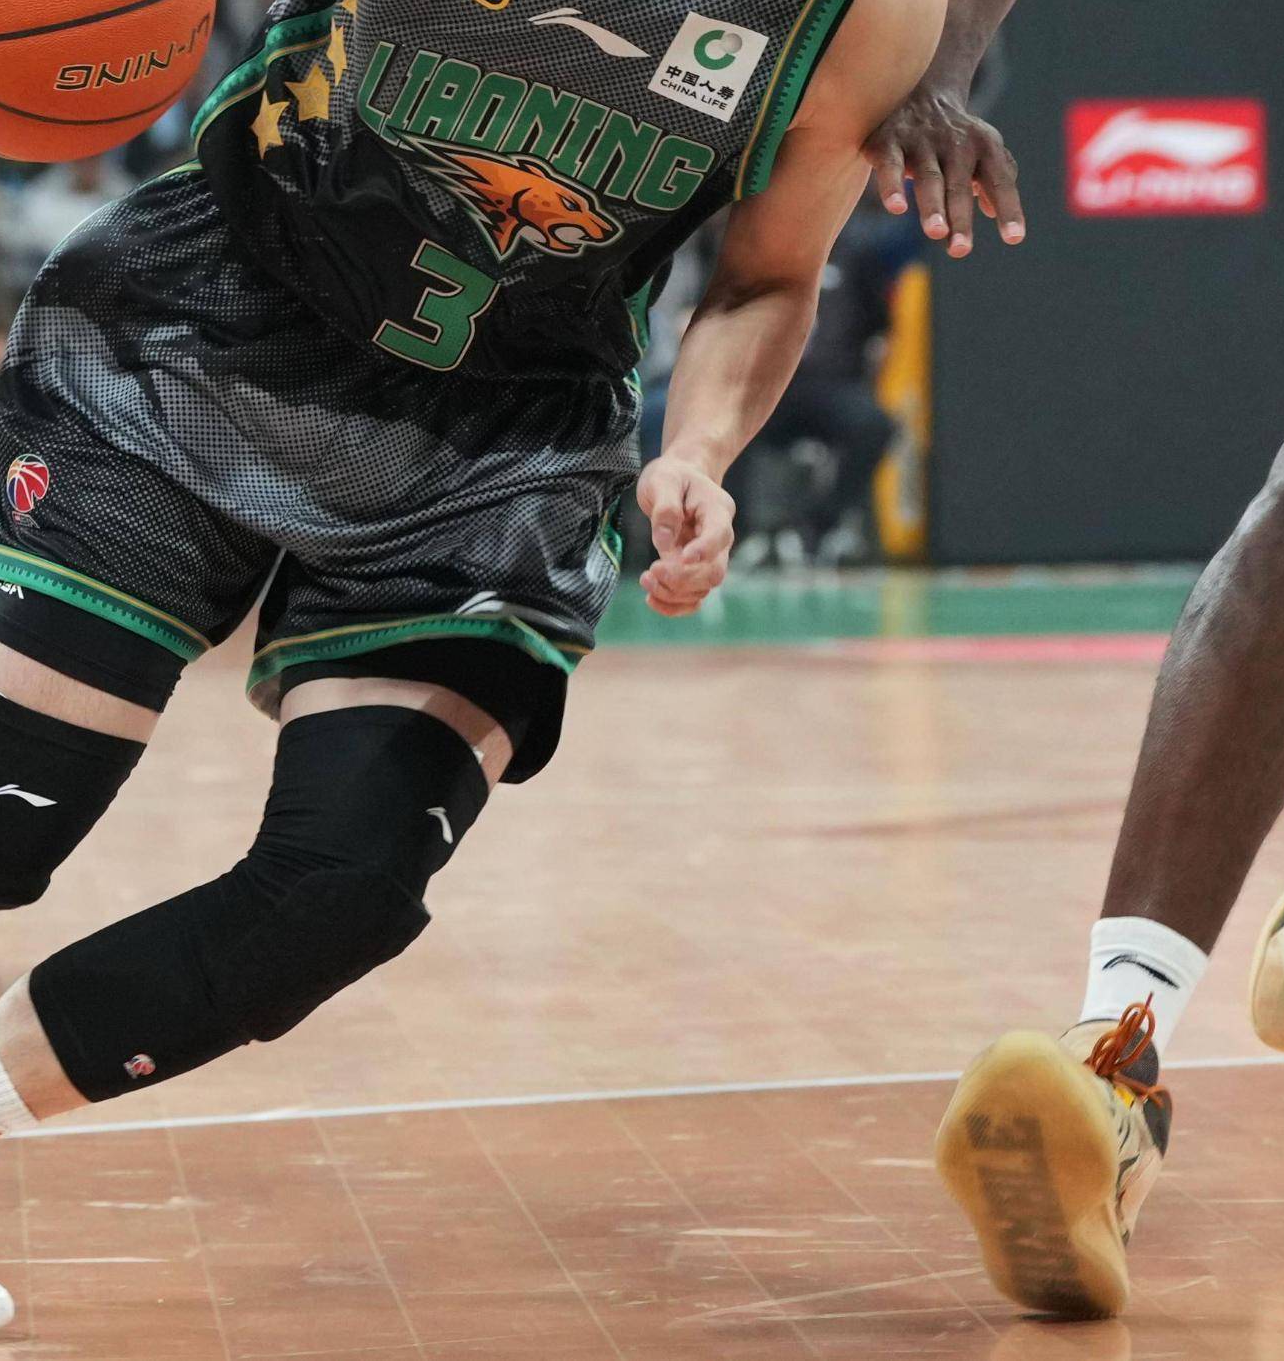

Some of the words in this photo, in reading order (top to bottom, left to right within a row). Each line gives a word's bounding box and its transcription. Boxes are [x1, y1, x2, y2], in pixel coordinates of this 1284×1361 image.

[54, 12, 210, 91] LI-NING
[665, 65, 735, 101] 中国人寿
[356, 39, 718, 212] LIAONING
[660, 78, 697, 99] CHINA
[700, 93, 728, 111] LIFE
[372, 238, 500, 373] 3
